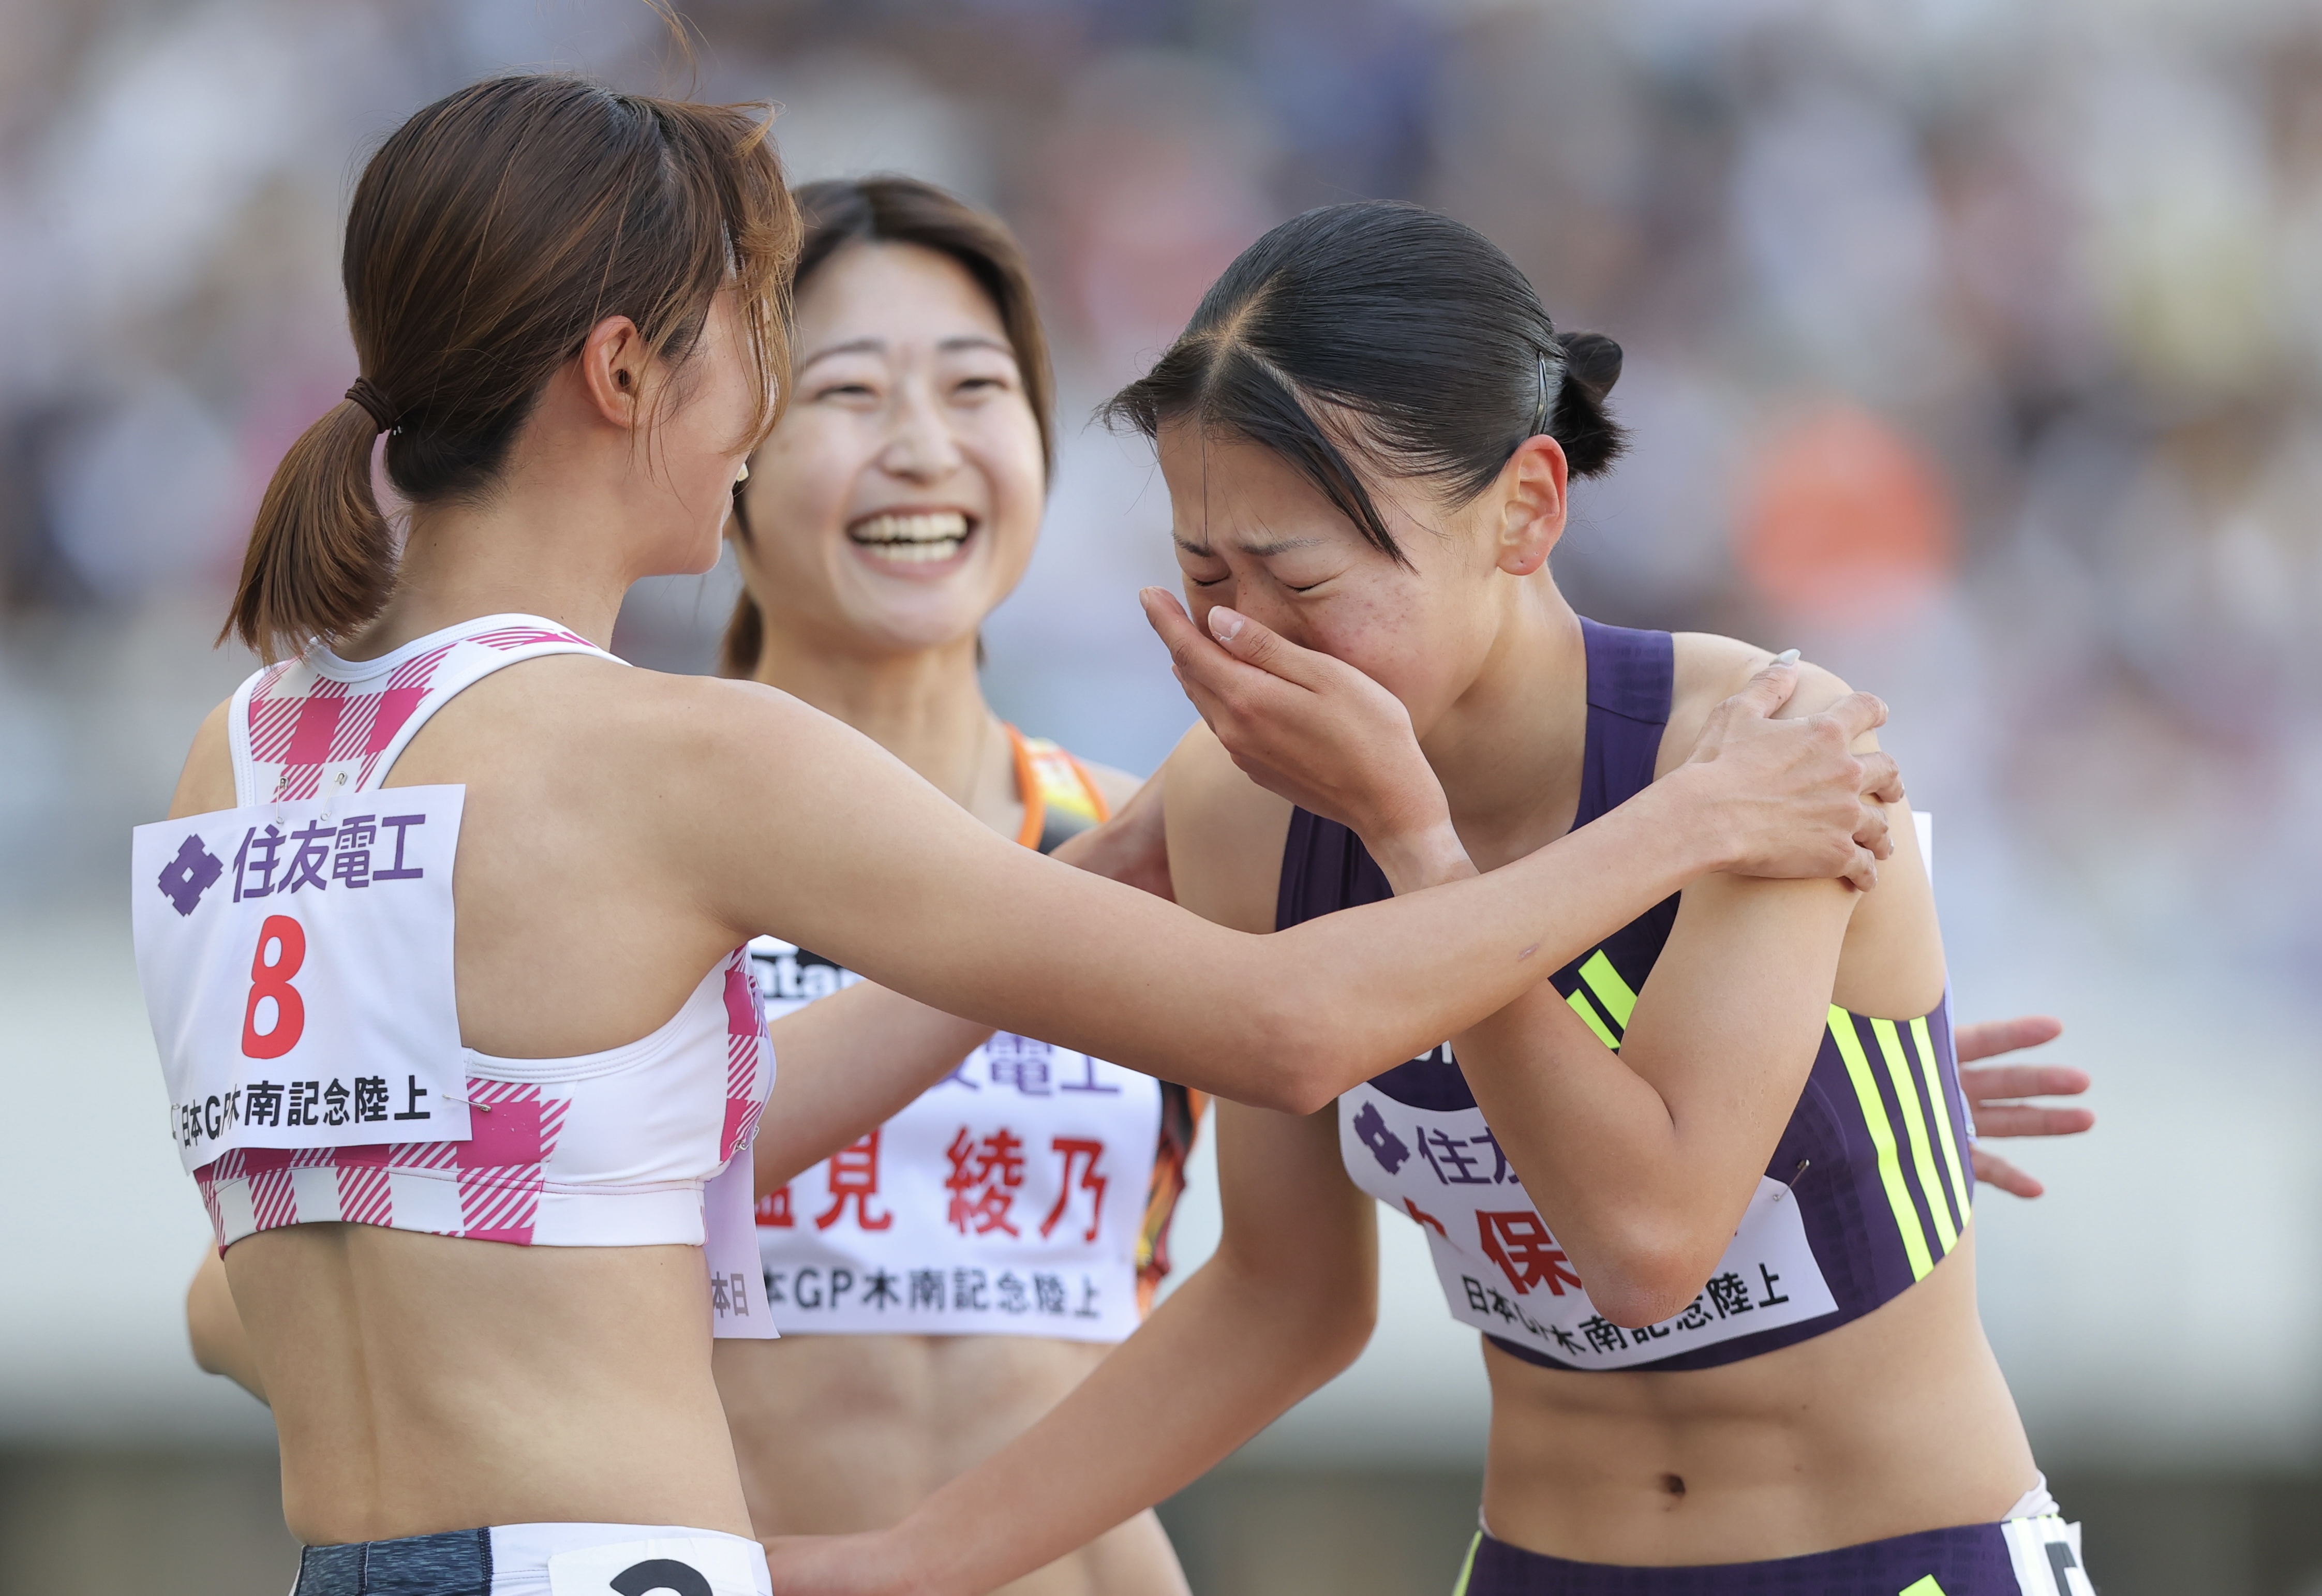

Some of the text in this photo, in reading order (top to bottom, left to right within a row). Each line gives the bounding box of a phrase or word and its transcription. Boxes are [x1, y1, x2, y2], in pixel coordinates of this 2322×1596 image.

[233, 814, 426, 903] 住友電工
[242, 915, 306, 1060] 8
[182, 1075, 430, 1150] 日本GP木南記念陸上
[945, 1125, 1109, 1242] 綾乃
